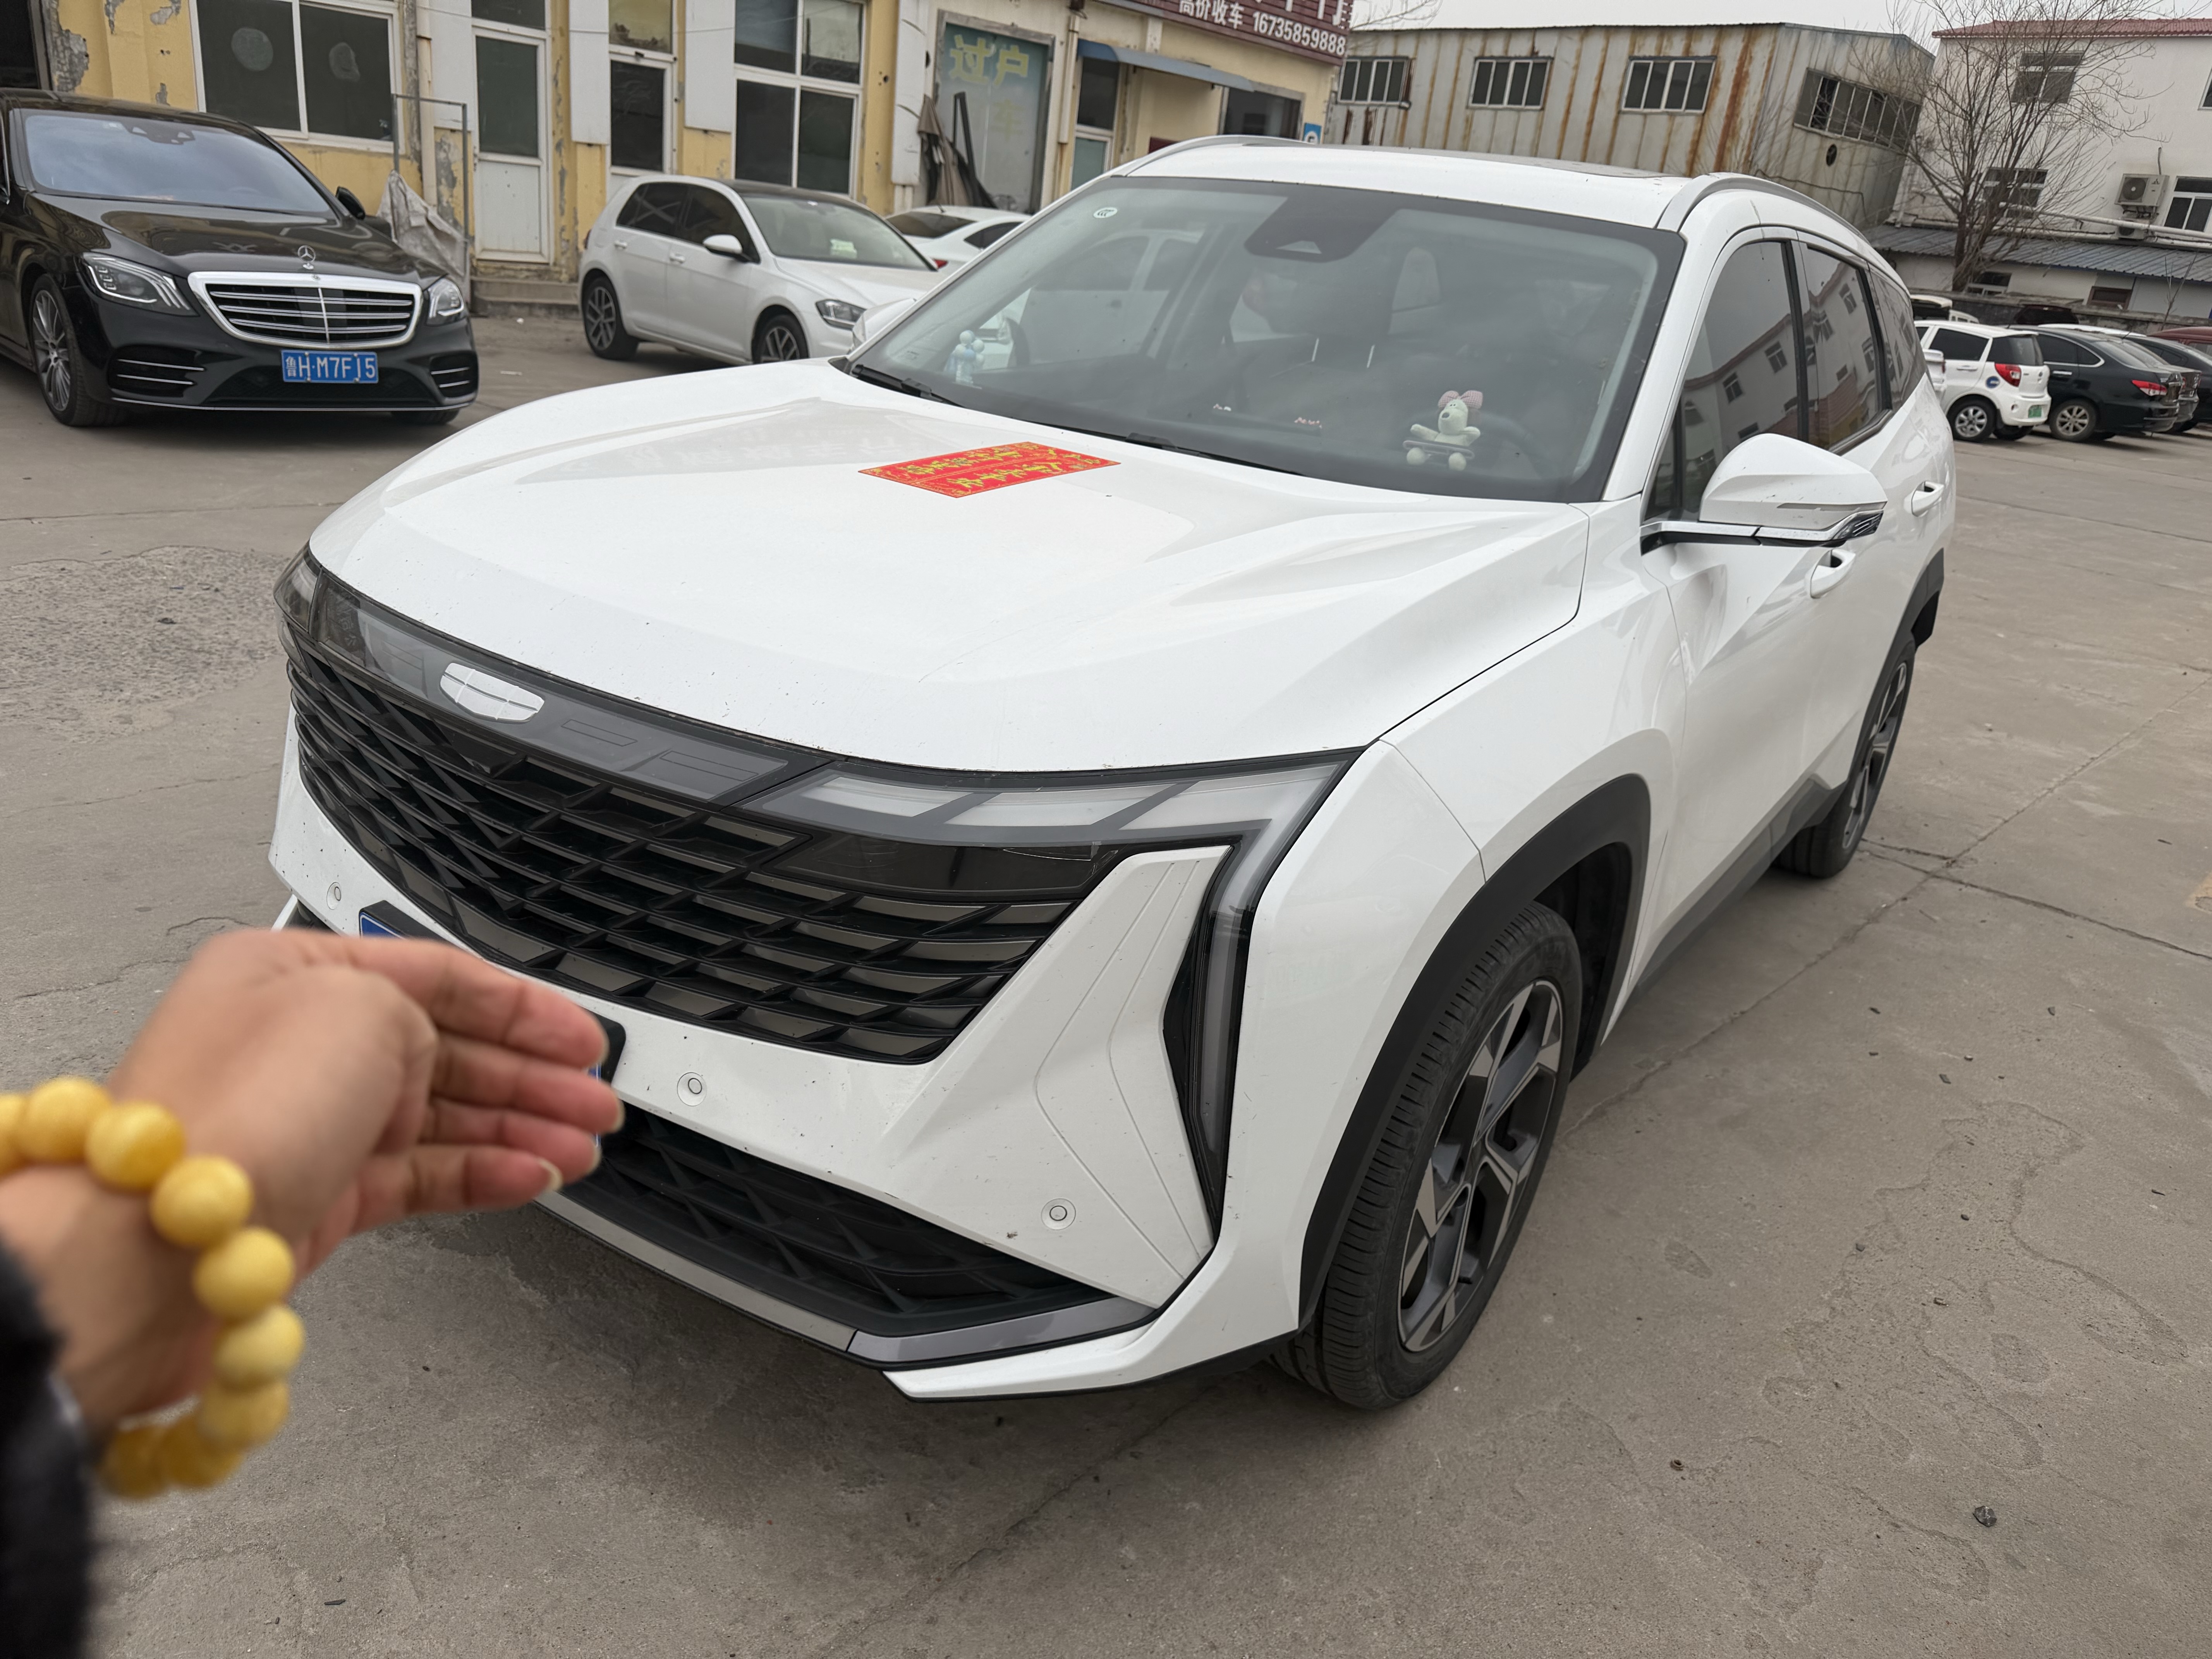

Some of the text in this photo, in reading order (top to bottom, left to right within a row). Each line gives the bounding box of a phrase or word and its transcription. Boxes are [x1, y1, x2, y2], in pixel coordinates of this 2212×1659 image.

[1179, 0, 1245, 29] 高价收车
[1253, 11, 1346, 55] 16735859888
[949, 34, 1029, 86] 过户
